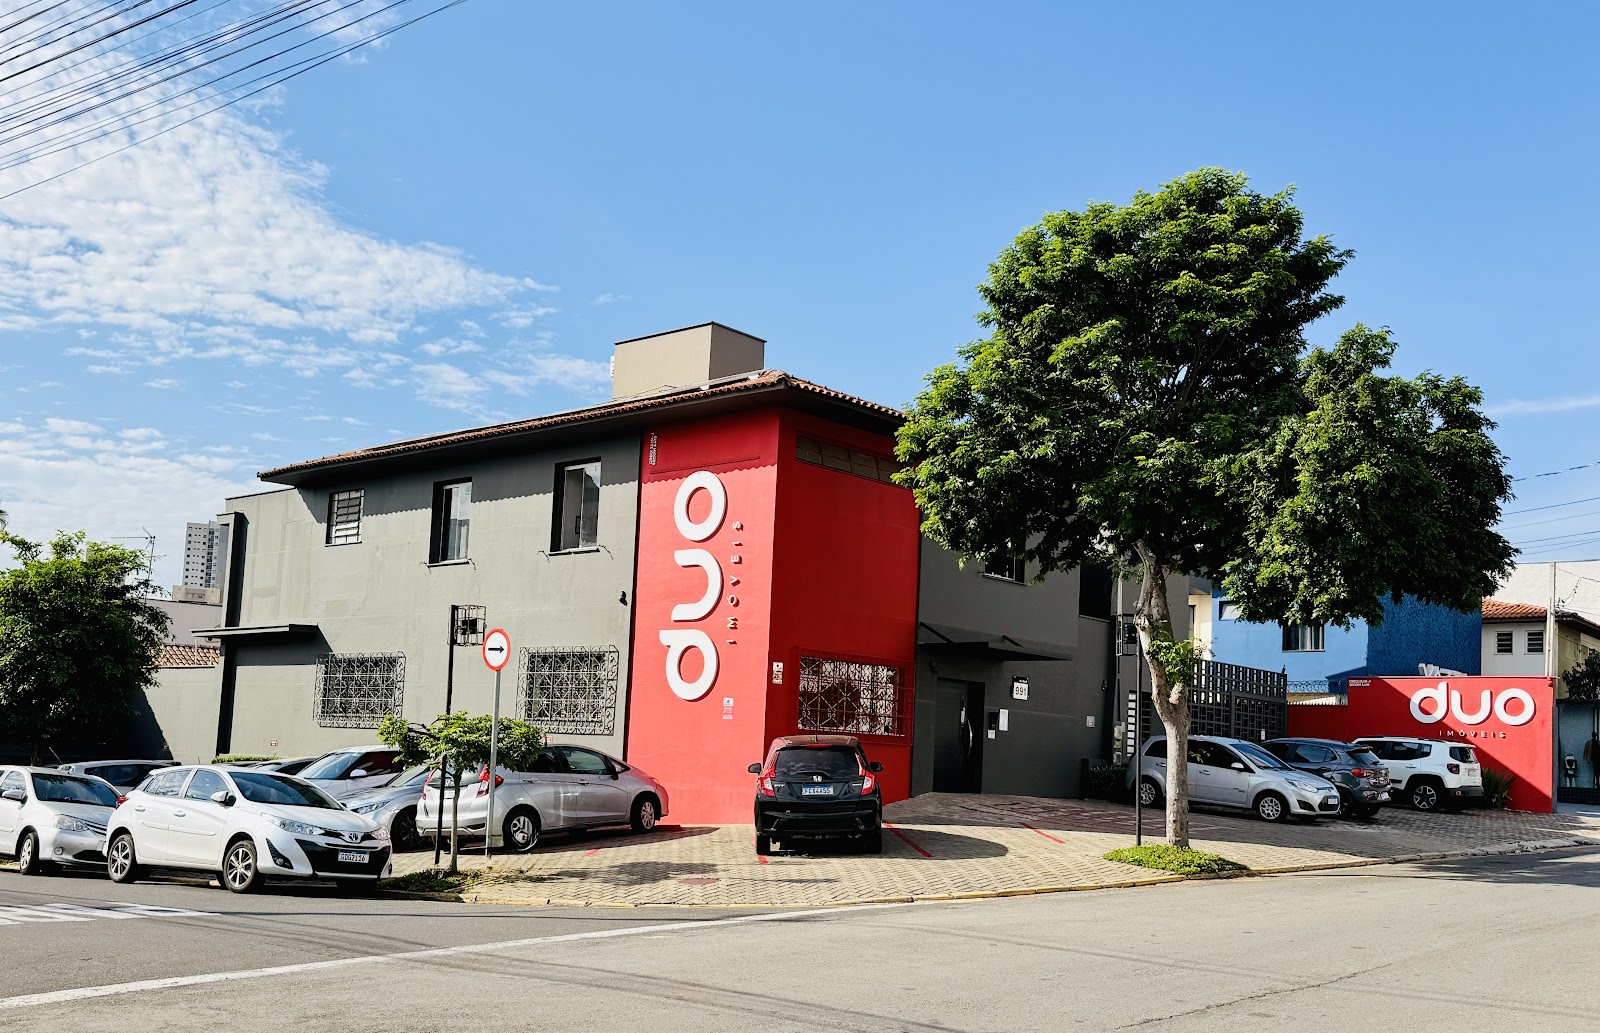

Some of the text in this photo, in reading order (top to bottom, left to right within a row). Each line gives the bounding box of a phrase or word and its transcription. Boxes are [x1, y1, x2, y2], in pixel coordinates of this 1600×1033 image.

[659, 470, 727, 702] duo
[726, 519, 743, 645] IMÓVEIS
[1015, 686, 1027, 697] 991
[1409, 681, 1536, 727] duo
[1439, 729, 1507, 738] IMÓVEIS
